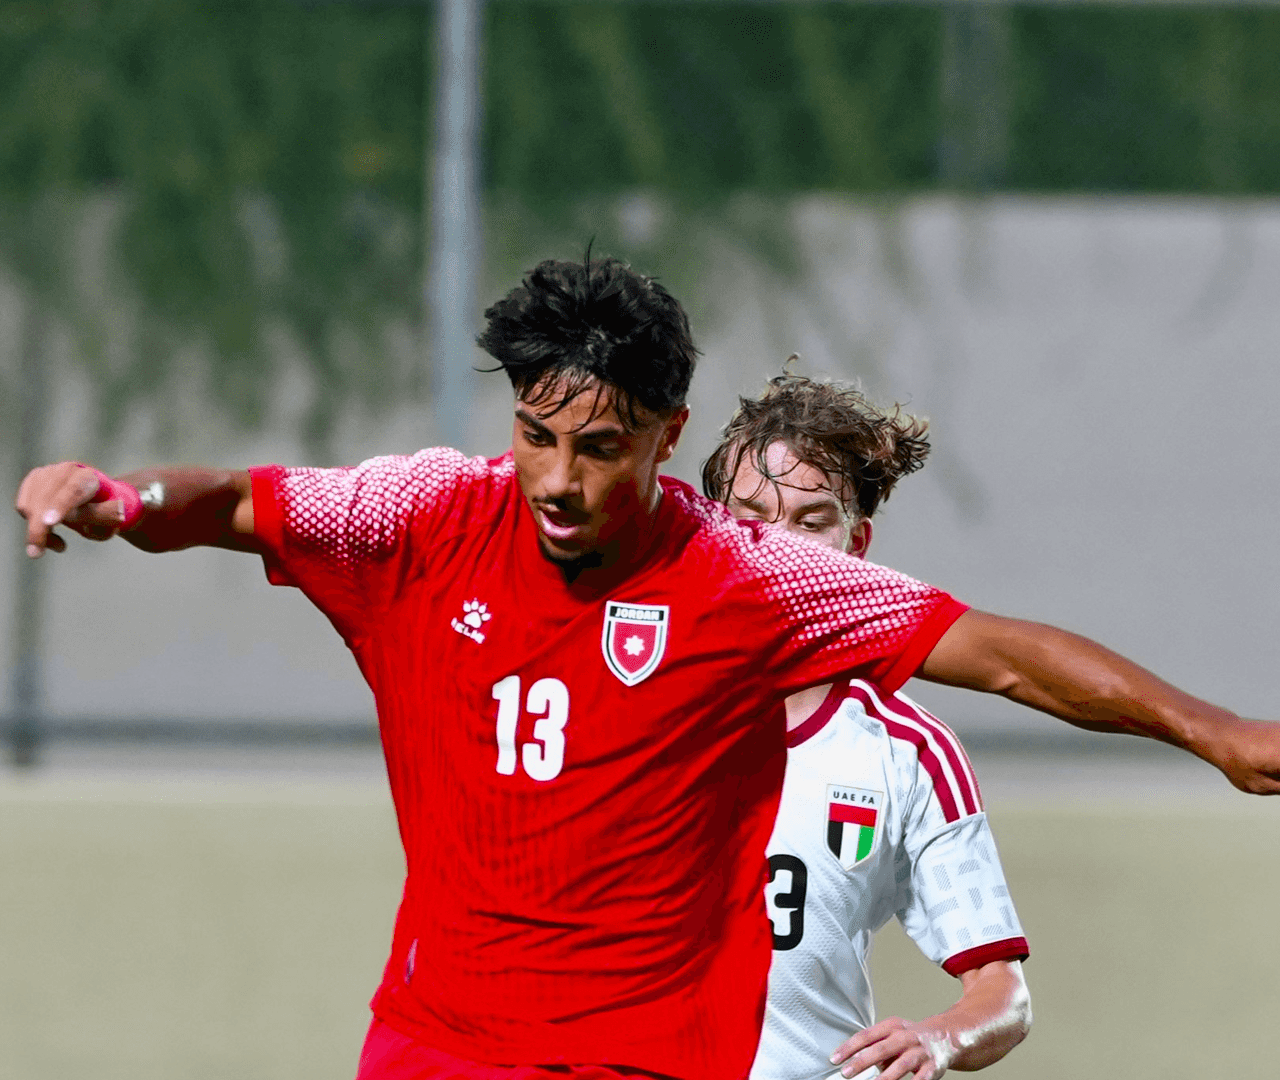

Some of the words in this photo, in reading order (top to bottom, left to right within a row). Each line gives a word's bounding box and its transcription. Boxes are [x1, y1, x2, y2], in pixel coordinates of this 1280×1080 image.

[615, 607, 660, 621] JORDAN
[492, 675, 570, 782] 13
[833, 791, 856, 802] UAE
[861, 795, 875, 804] FA
[767, 854, 807, 951] 3
